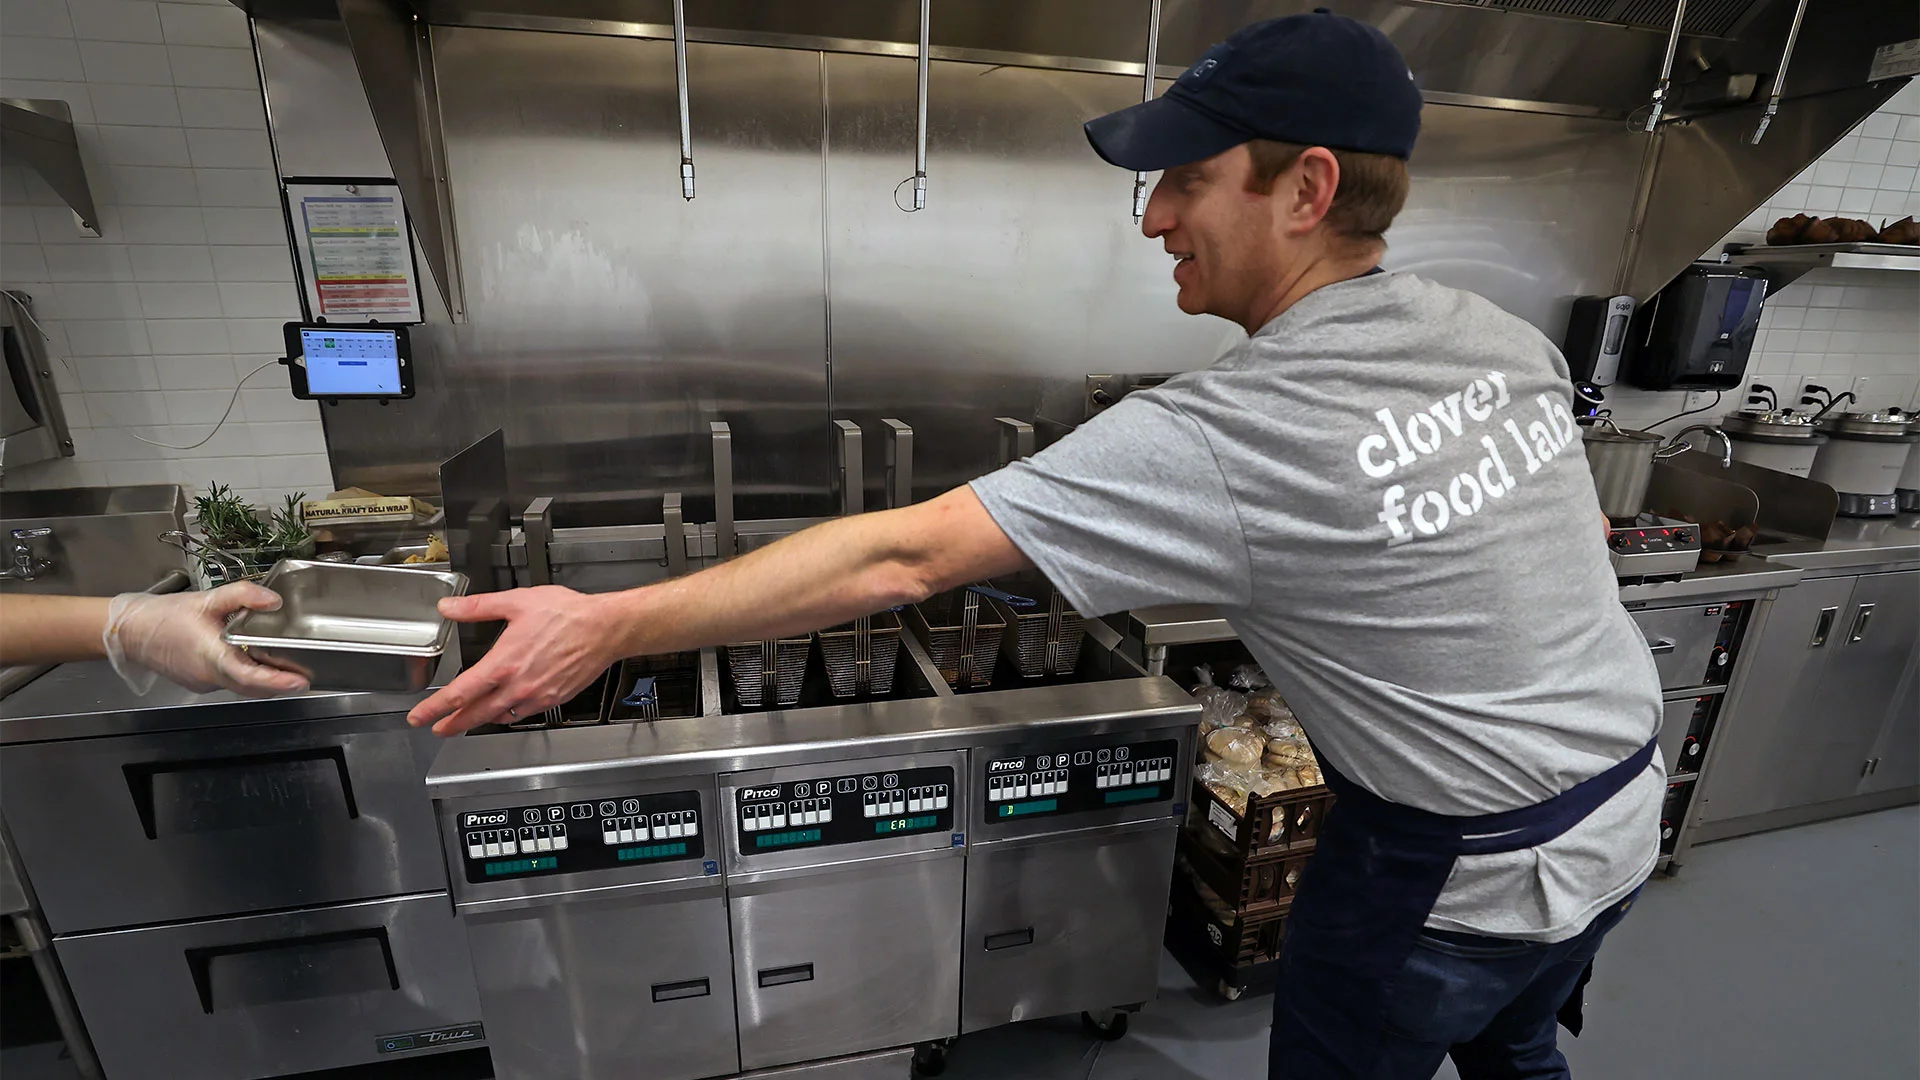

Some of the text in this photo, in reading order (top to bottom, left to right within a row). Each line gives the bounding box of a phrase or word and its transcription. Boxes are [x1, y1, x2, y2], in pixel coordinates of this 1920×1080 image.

[1357, 371, 1510, 478] clover
[1378, 394, 1574, 547] food lab
[305, 508, 340, 518] NATURAL
[341, 506, 366, 514] KRAFT
[991, 760, 1023, 771] PITCO
[1059, 756, 1066, 765] P
[744, 789, 778, 799] PITCO
[820, 784, 827, 793] P
[467, 814, 506, 825] PITCO
[552, 809, 560, 819] P
